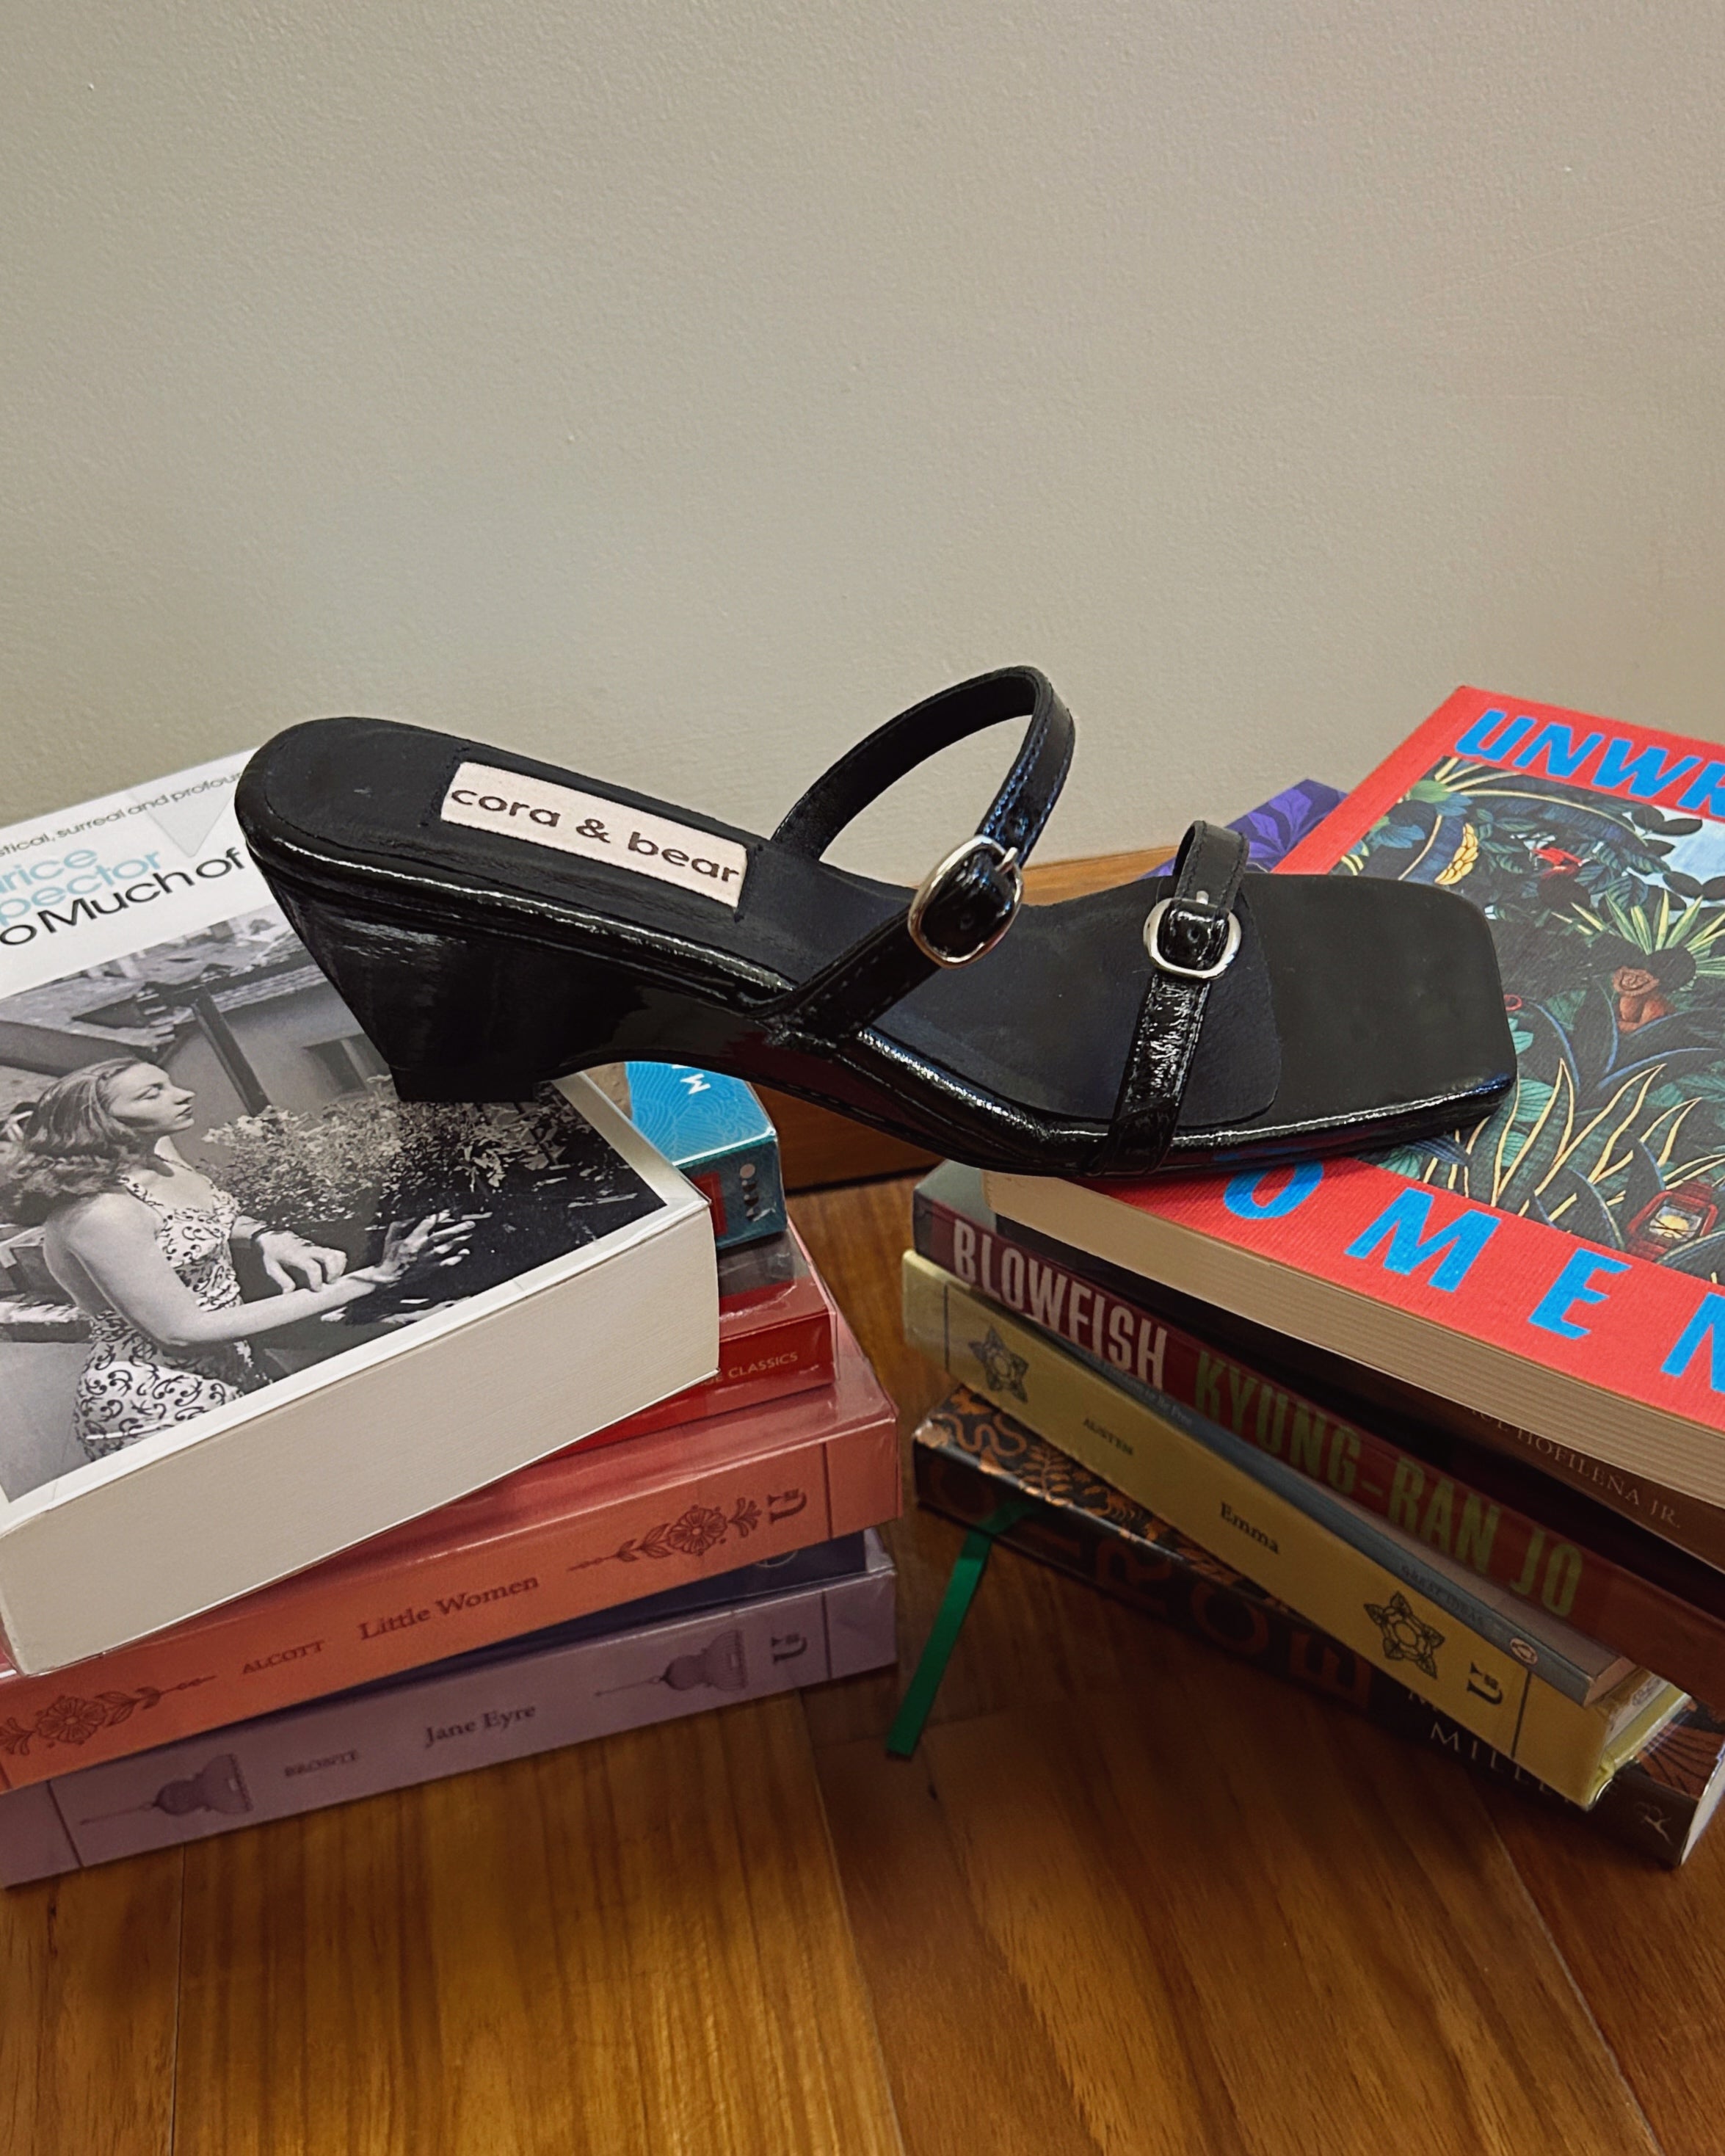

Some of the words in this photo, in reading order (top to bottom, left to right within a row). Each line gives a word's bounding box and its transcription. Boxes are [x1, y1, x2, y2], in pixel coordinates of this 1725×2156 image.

[57, 809, 126, 838] surreal
[128, 794, 170, 815] and
[450, 788, 562, 828] cora
[575, 818, 611, 844] &
[628, 831, 740, 882] bear
[0, 849, 98, 893] rice
[0, 850, 161, 927] pector
[37, 871, 195, 934] Much
[195, 846, 245, 879] of
[727, 1351, 799, 1379] CLASSICS
[954, 1218, 1168, 1390] BLOWFISH
[1194, 1349, 1501, 1576] KYUNG-RAN
[1508, 1531, 1583, 1616] JO
[1220, 1501, 1281, 1555] Emma
[1649, 1499, 1681, 1528] JR.
[242, 1639, 325, 1675] ALCOTT
[357, 1607, 431, 1641] Little
[435, 1576, 540, 1616] Women
[424, 1720, 478, 1749] Jane
[482, 1705, 536, 1732] Eyre
